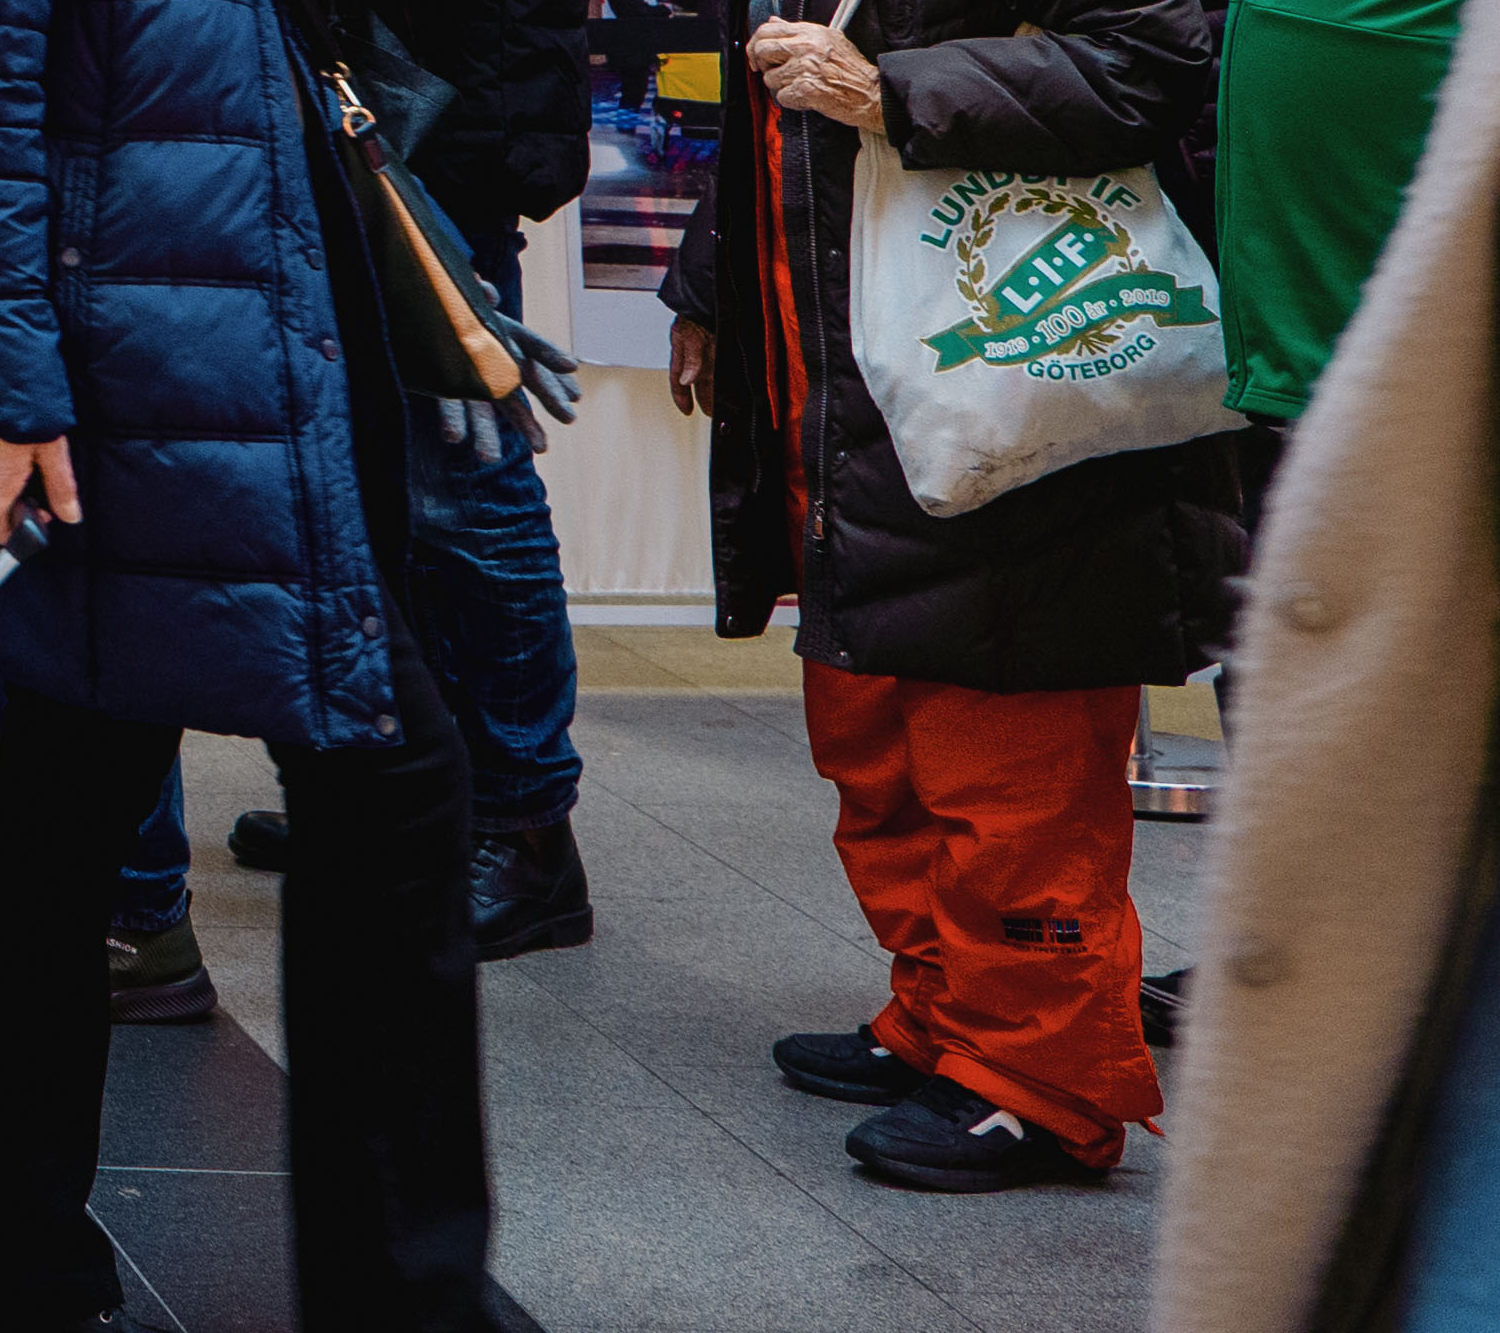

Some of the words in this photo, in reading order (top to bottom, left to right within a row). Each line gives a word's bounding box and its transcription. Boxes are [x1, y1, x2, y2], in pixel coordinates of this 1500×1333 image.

[920, 171, 1070, 250] LUND
[1090, 176, 1143, 209] IF
[983, 337, 1030, 359] 1919
[1035, 303, 1087, 347] 100
[1119, 286, 1172, 311] 2019
[1025, 332, 1159, 382] GÖTEBORG
